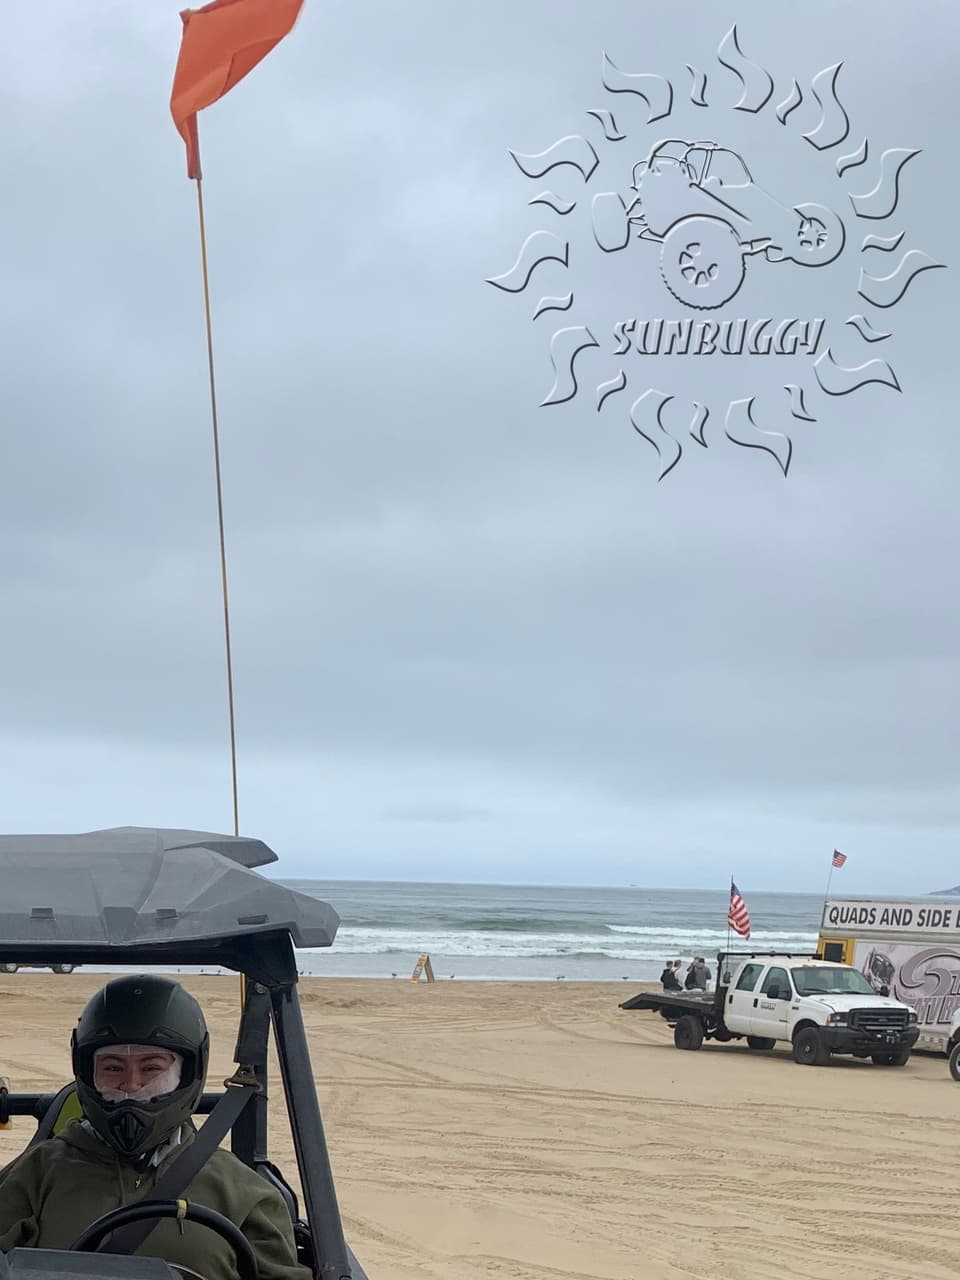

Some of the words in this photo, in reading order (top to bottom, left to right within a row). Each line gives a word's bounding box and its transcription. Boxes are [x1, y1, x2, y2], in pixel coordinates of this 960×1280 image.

[828, 906, 877, 926] QUADS
[879, 908, 914, 927] AND
[916, 908, 952, 928] SIDE
